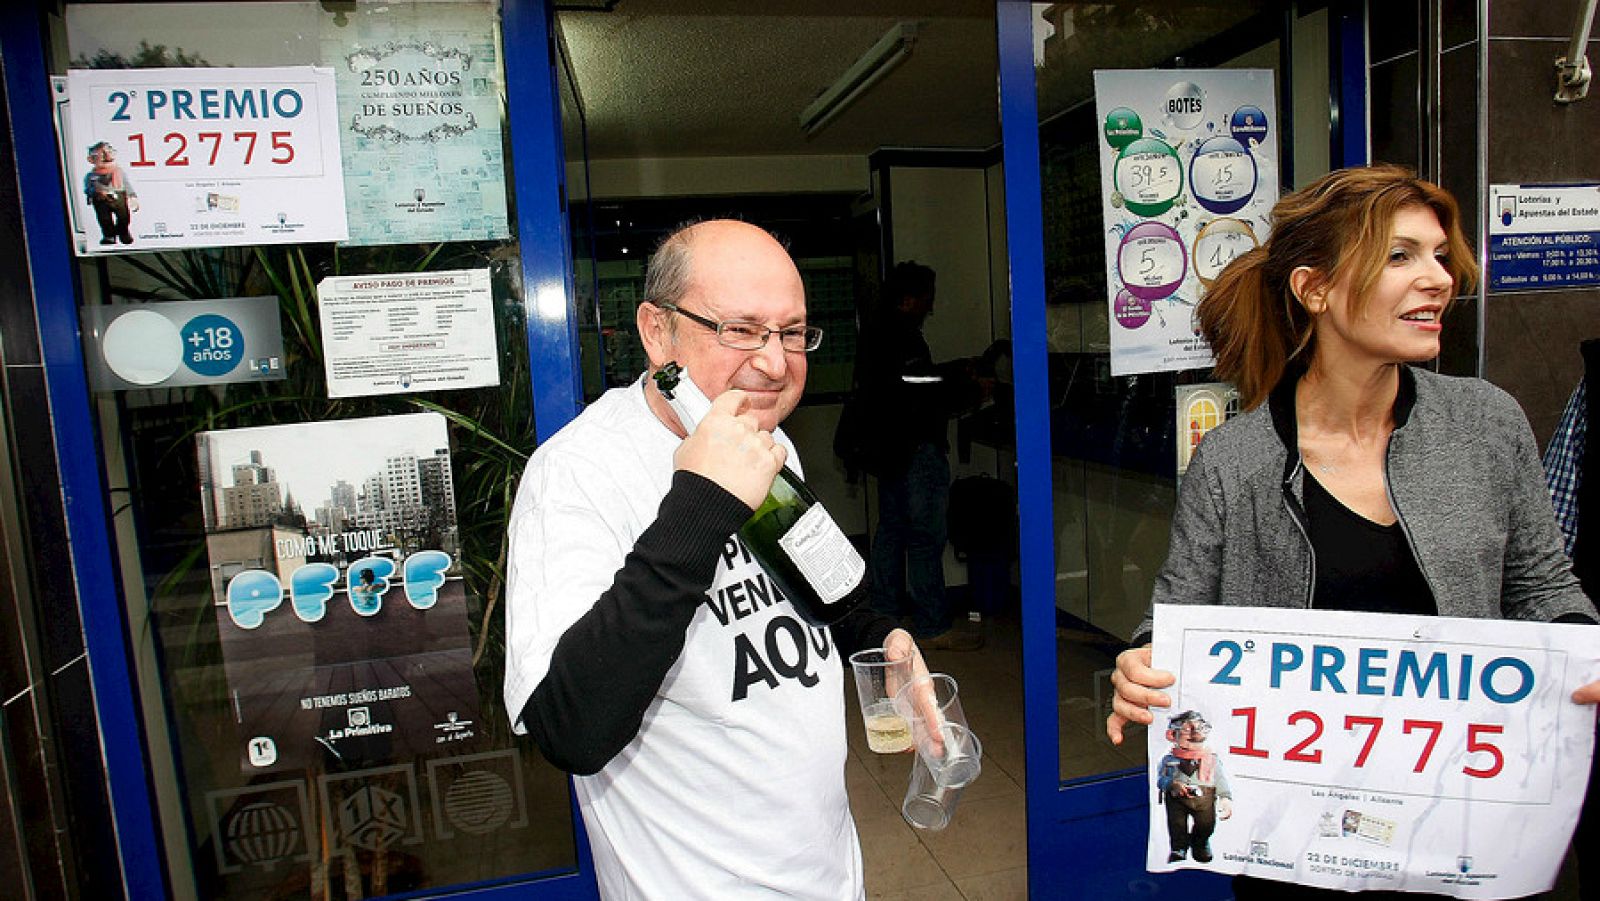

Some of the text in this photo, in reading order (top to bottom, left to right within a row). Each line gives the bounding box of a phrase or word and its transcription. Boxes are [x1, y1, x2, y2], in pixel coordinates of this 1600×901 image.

[361, 67, 460, 86] 250 AÑOS
[147, 88, 304, 120] PREMIO
[363, 100, 464, 117] DE SUEÑOS
[1168, 97, 1202, 113] BOTES
[127, 131, 295, 167] 12775
[1542, 236, 1554, 245] AL
[1139, 247, 1155, 275] 5
[188, 327, 233, 349] +18
[193, 348, 232, 362] años
[276, 535, 316, 559] COMO
[318, 533, 341, 555] ME
[1269, 641, 1536, 704] PREMIO
[313, 693, 348, 709] TENEMOS
[348, 688, 378, 704] SUEÑOS
[378, 685, 412, 701] BARATOS
[329, 723, 393, 739] La Primitiva
[1228, 706, 1505, 780] 12775
[1307, 852, 1400, 872] 22 DE DICIEMBRE
